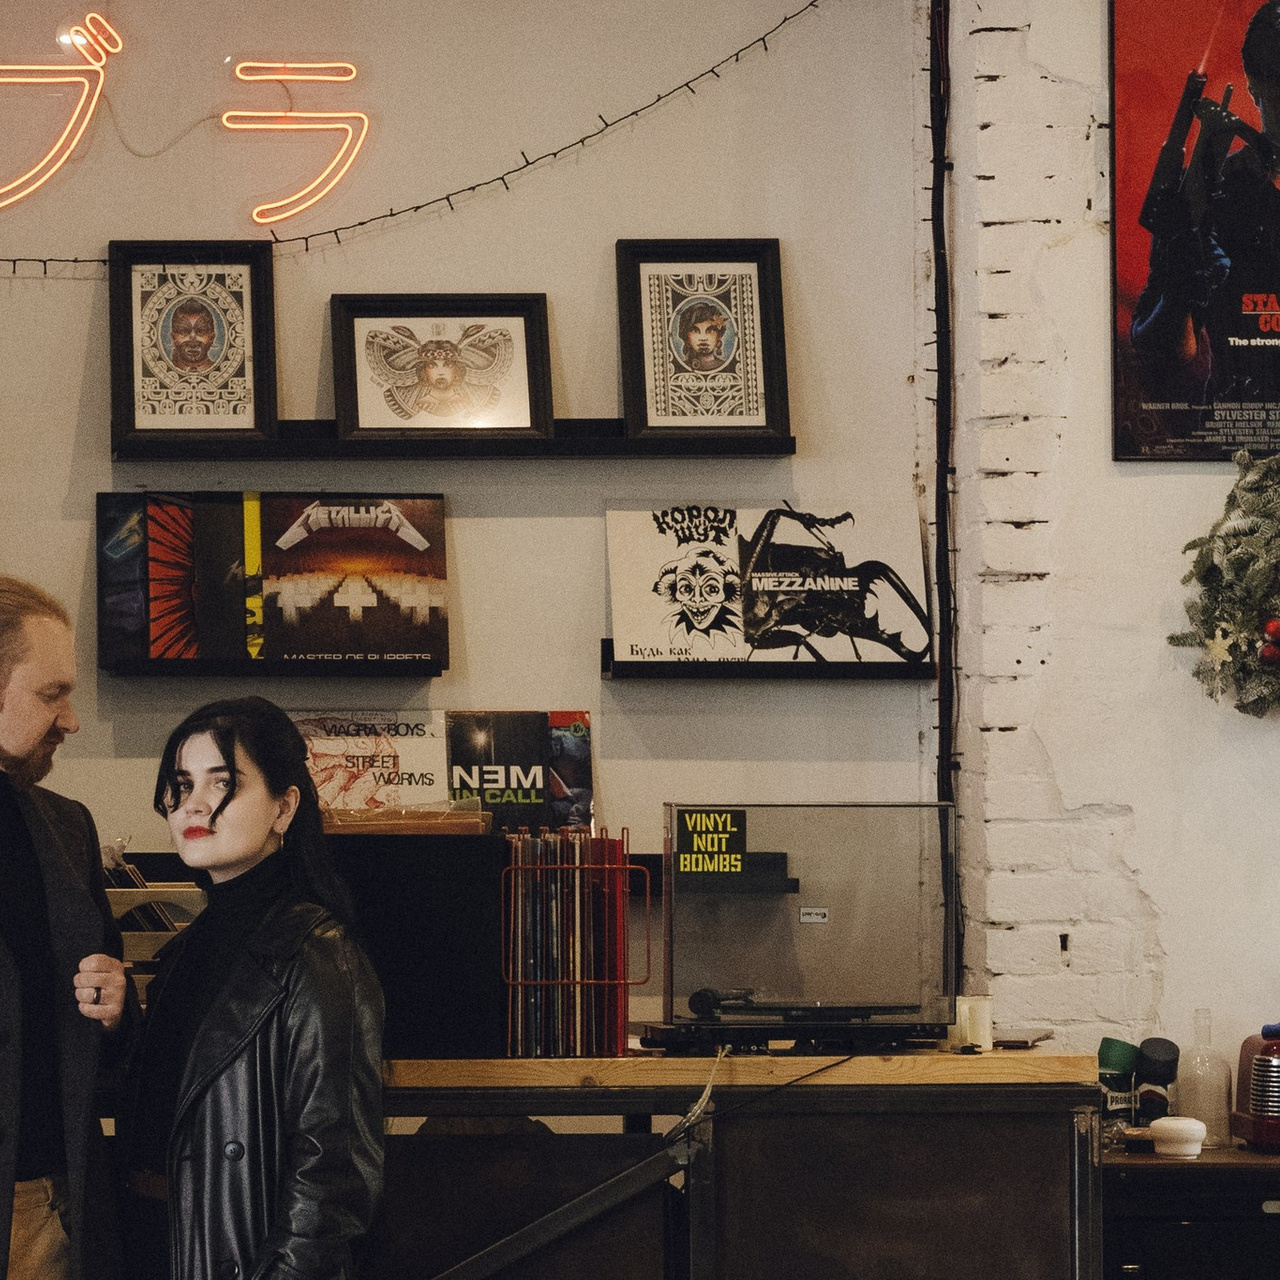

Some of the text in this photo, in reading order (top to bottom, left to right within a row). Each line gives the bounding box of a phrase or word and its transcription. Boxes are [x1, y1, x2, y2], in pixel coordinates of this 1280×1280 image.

[1227, 336, 1249, 347] The
[1214, 410, 1267, 420] SYLVESTER
[275, 499, 431, 552] METALLICA
[652, 505, 737, 535] КОРОЛ
[672, 522, 730, 547] ШУТ
[751, 576, 860, 591] MEZZANINE
[629, 643, 692, 659] Будь как
[323, 722, 426, 737] VIAGRA BOYS
[345, 754, 400, 769] STREET
[371, 771, 435, 787] WORMS
[485, 789, 544, 804] CALL
[684, 813, 738, 832] VINYL
[693, 833, 730, 852] NOT
[679, 853, 742, 872] BOMBS
